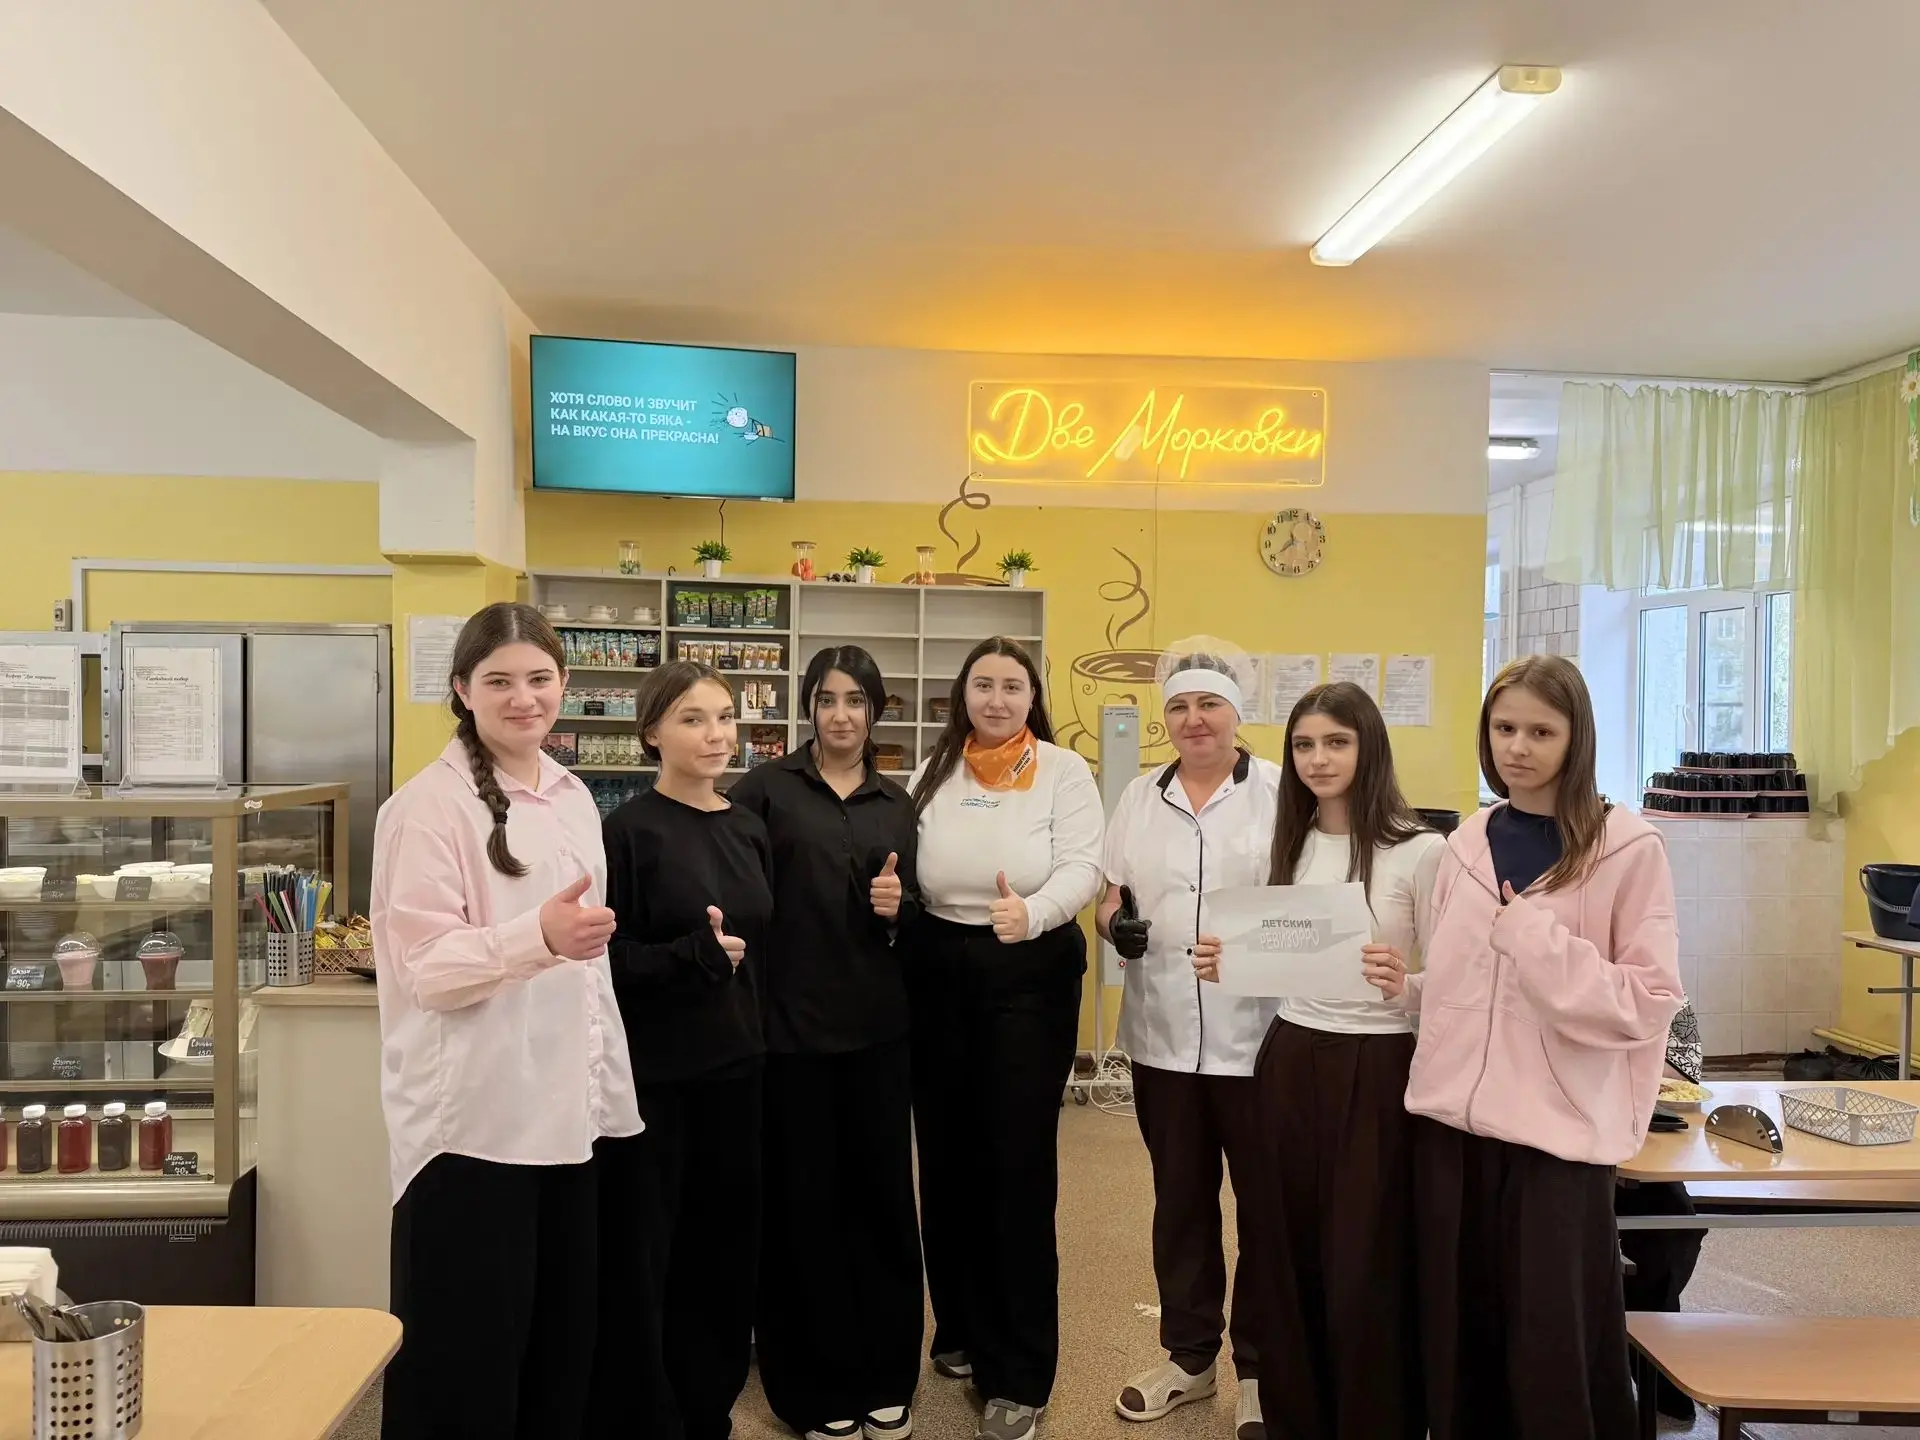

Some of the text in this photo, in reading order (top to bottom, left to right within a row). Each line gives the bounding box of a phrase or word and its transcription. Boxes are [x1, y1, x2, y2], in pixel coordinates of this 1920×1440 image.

[550, 392, 697, 412] ХОТЯ СЛОВО И ЗВУЧИТ
[550, 408, 578, 420] КАК
[581, 410, 646, 424] КАКАЯ-ТО
[650, 414, 684, 426] БЯКА
[551, 424, 720, 444] НА ВКУС ОНА ПРЕКРАСНА!
[973, 387, 1323, 479] Две Морковки
[1262, 918, 1312, 928] ДЕТСКИЙ
